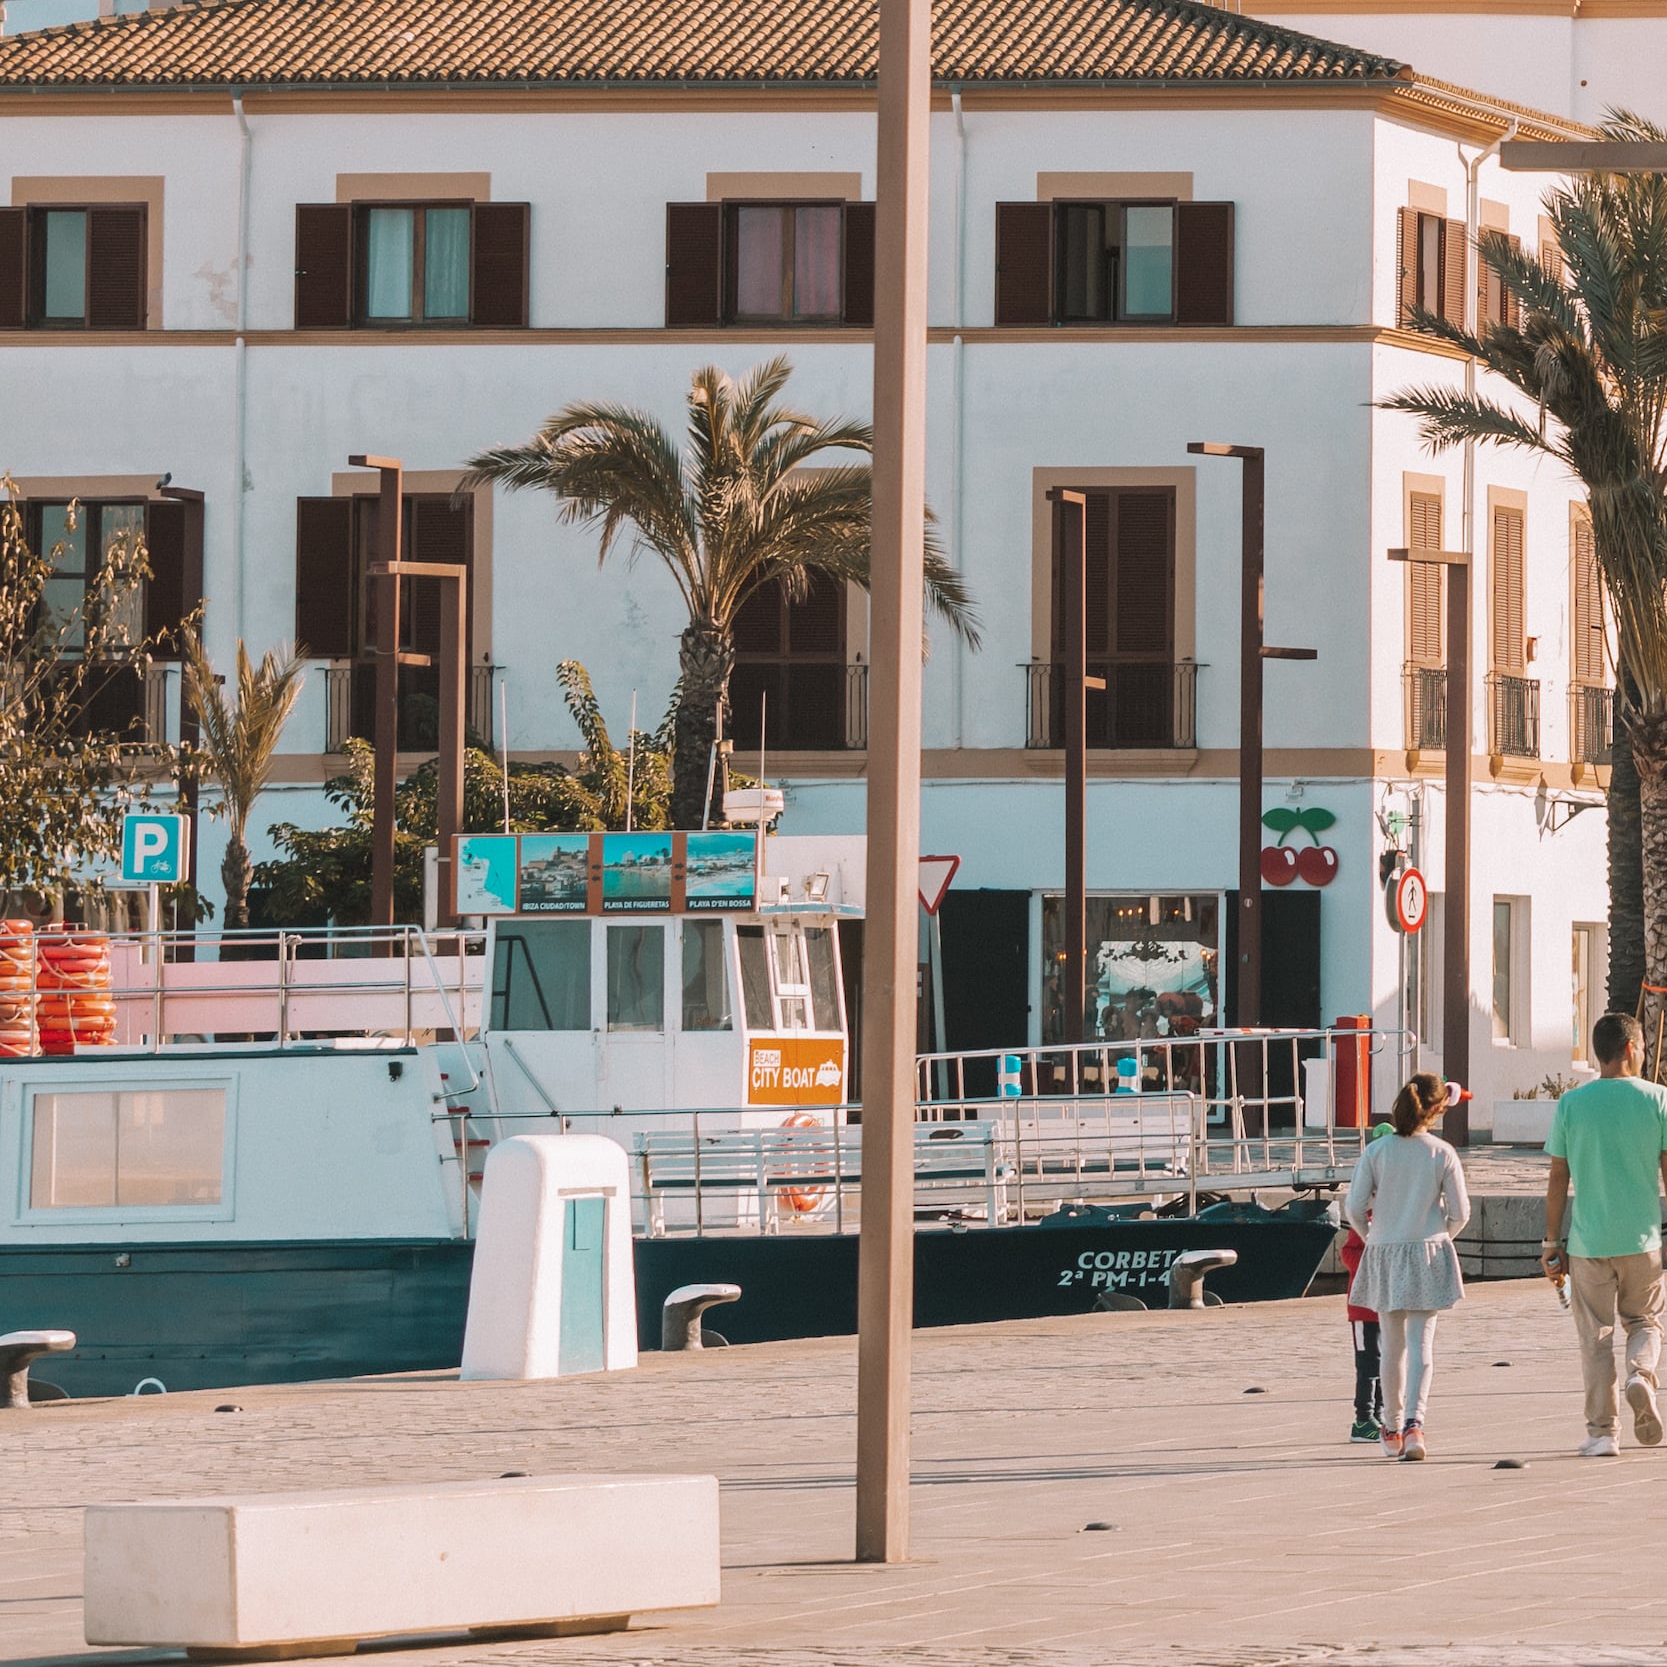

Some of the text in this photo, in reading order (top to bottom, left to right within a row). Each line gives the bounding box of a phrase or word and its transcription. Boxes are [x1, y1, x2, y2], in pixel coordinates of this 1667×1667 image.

[522, 901, 539, 910] IBIZA
[604, 900, 670, 910] PLAYA DE FIGUERETAS
[689, 900, 710, 909] PLAYA
[729, 899, 752, 908] BOSSA
[755, 1051, 780, 1064] BEACH
[752, 1067, 816, 1089] CITY BOAT
[1078, 1249, 1189, 1269] CORBET
